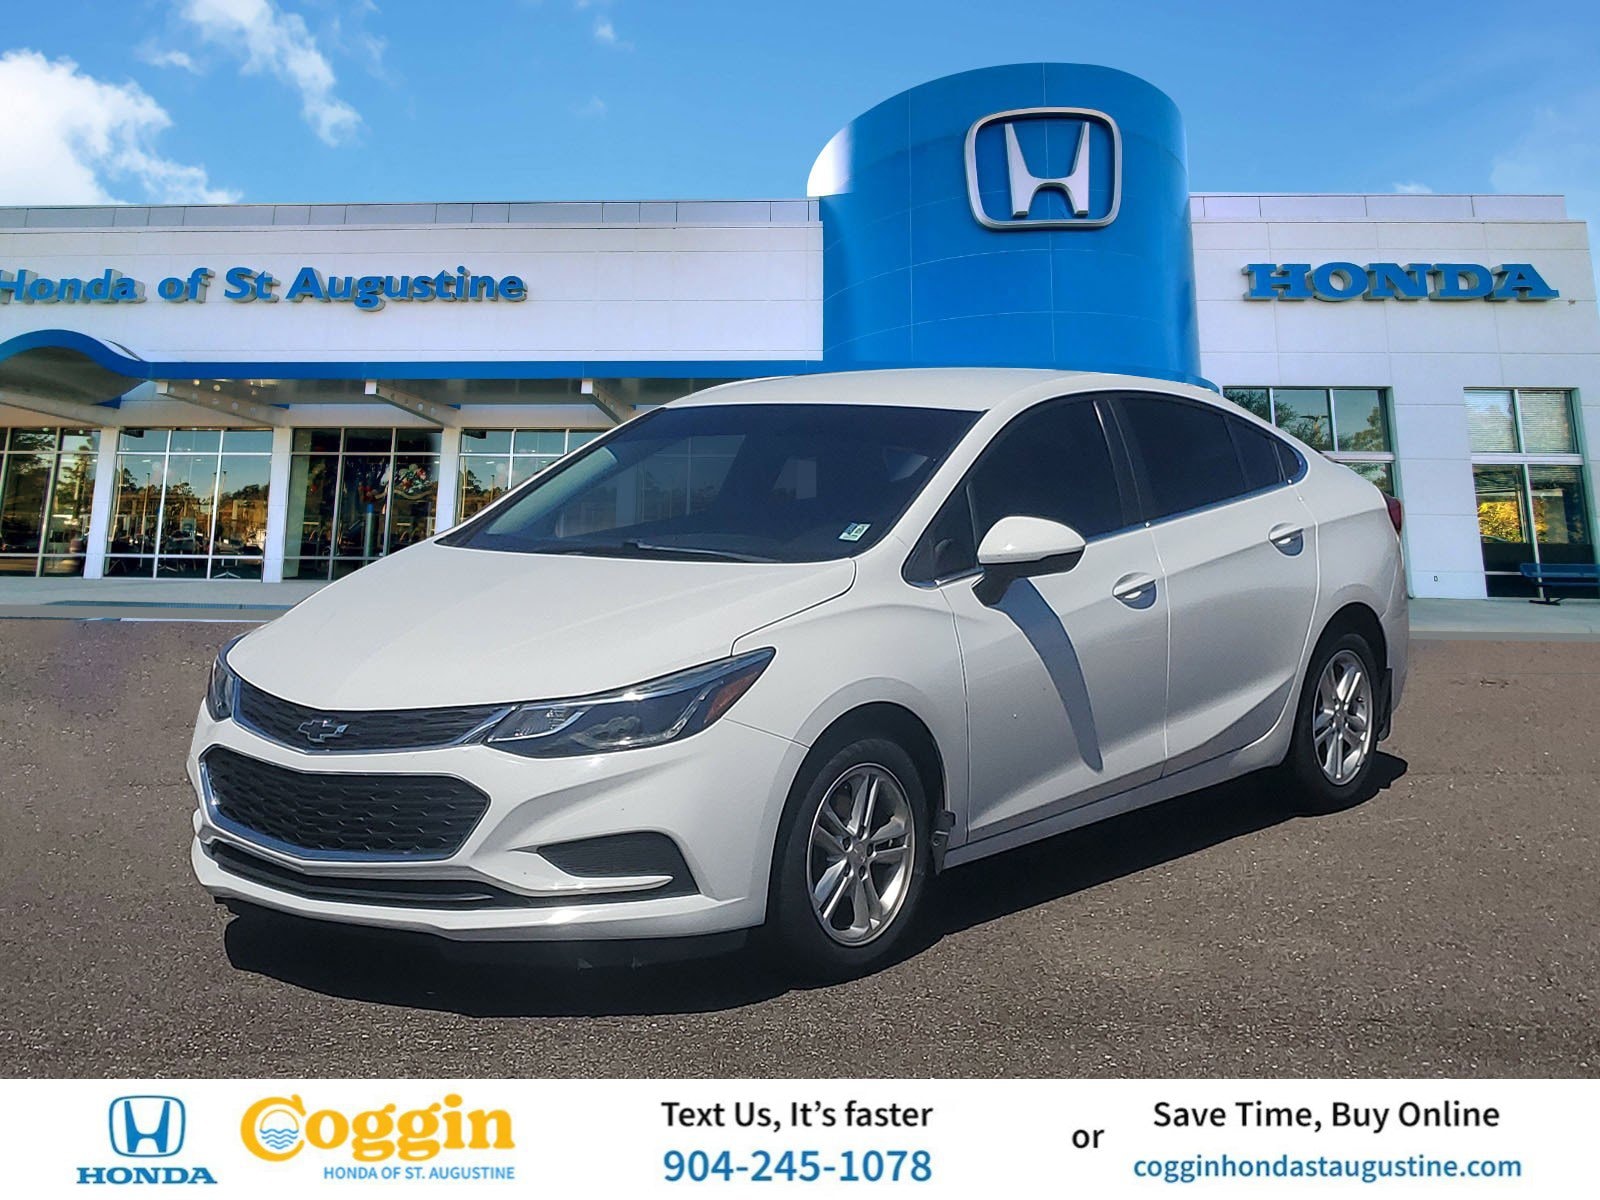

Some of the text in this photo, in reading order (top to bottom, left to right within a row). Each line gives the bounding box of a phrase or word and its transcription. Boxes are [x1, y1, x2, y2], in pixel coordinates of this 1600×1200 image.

[0, 266, 527, 311] Honda of St Augustine
[1243, 262, 1560, 301] HONDA
